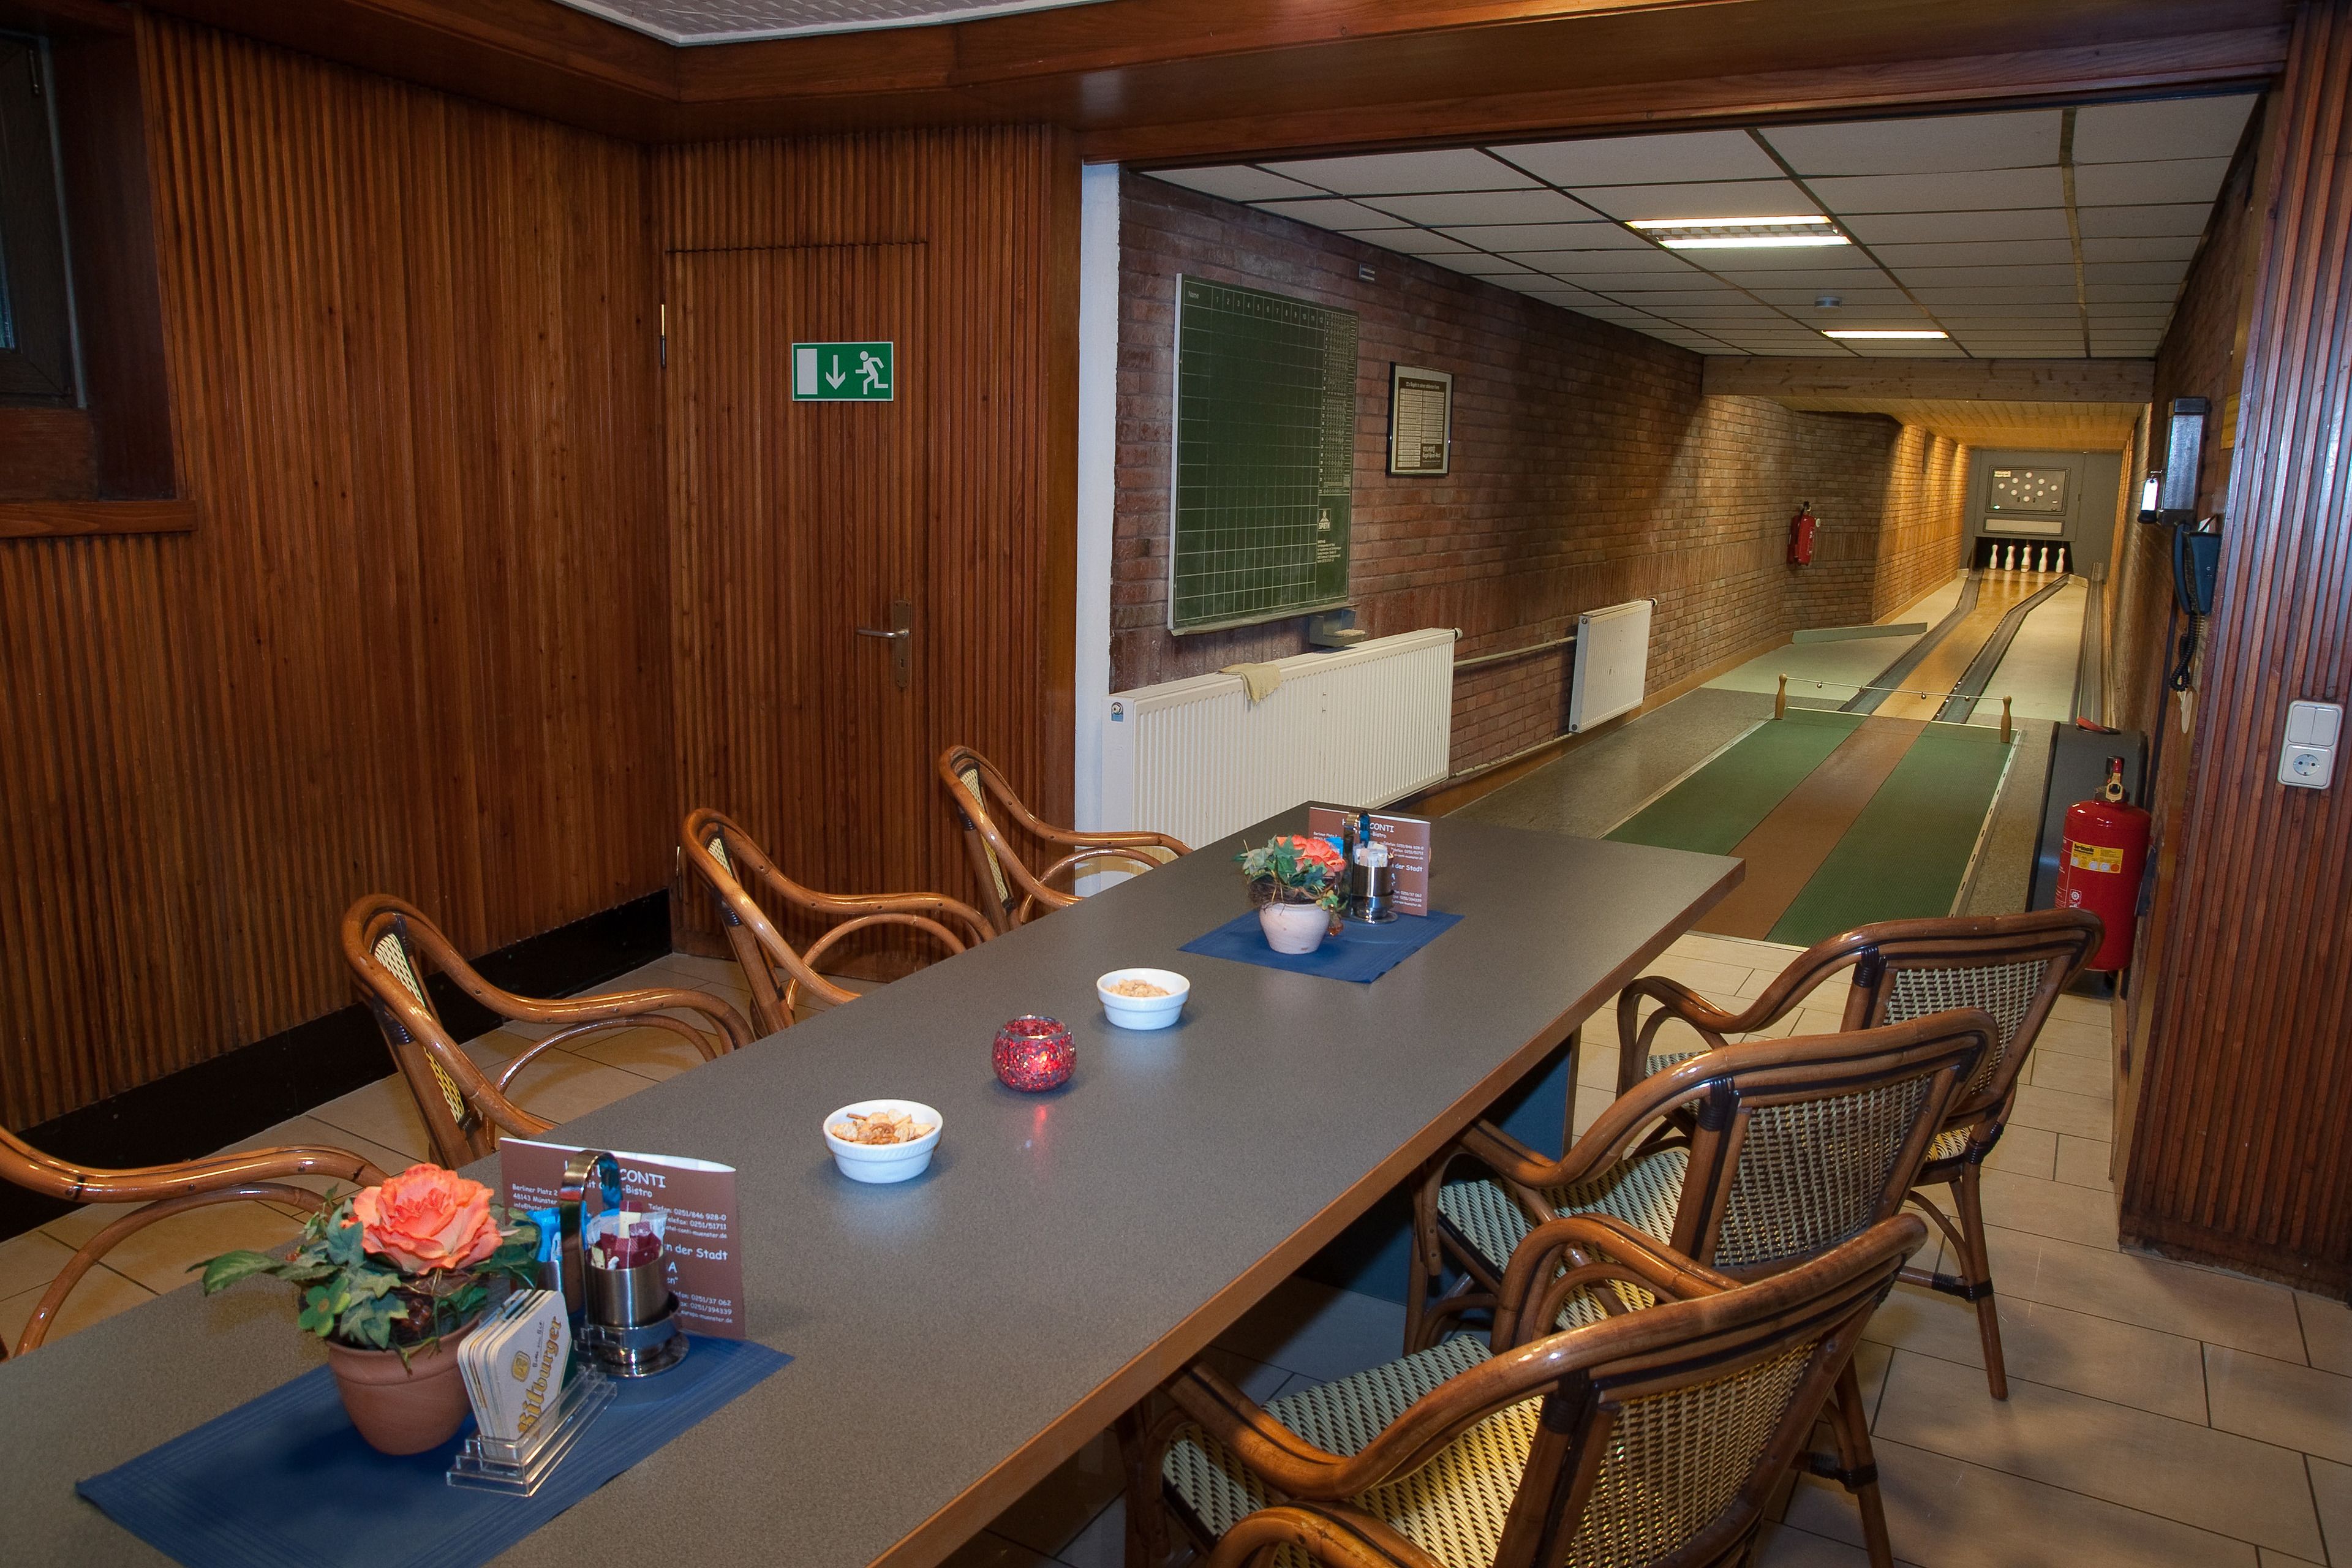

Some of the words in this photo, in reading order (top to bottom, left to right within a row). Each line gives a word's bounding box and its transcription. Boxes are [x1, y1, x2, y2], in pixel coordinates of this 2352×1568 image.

[1188, 290, 1200, 300] Name
[619, 1169, 666, 1188] CONTI
[512, 1183, 535, 1194] Berliner
[537, 1187, 552, 1196] Platz
[513, 1193, 531, 1201] 48143
[533, 1196, 558, 1205] Münster
[673, 1208, 705, 1220] 0251/846
[705, 1213, 727, 1223] 928-0
[667, 1216, 687, 1226] elefax:
[689, 1220, 727, 1231] 0251/51711
[675, 1243, 693, 1255] der
[696, 1247, 729, 1261] Stadt
[691, 1293, 717, 1305] 0251/37
[690, 1302, 733, 1316] 0251/394339
[517, 1316, 562, 1433] Bitburger
